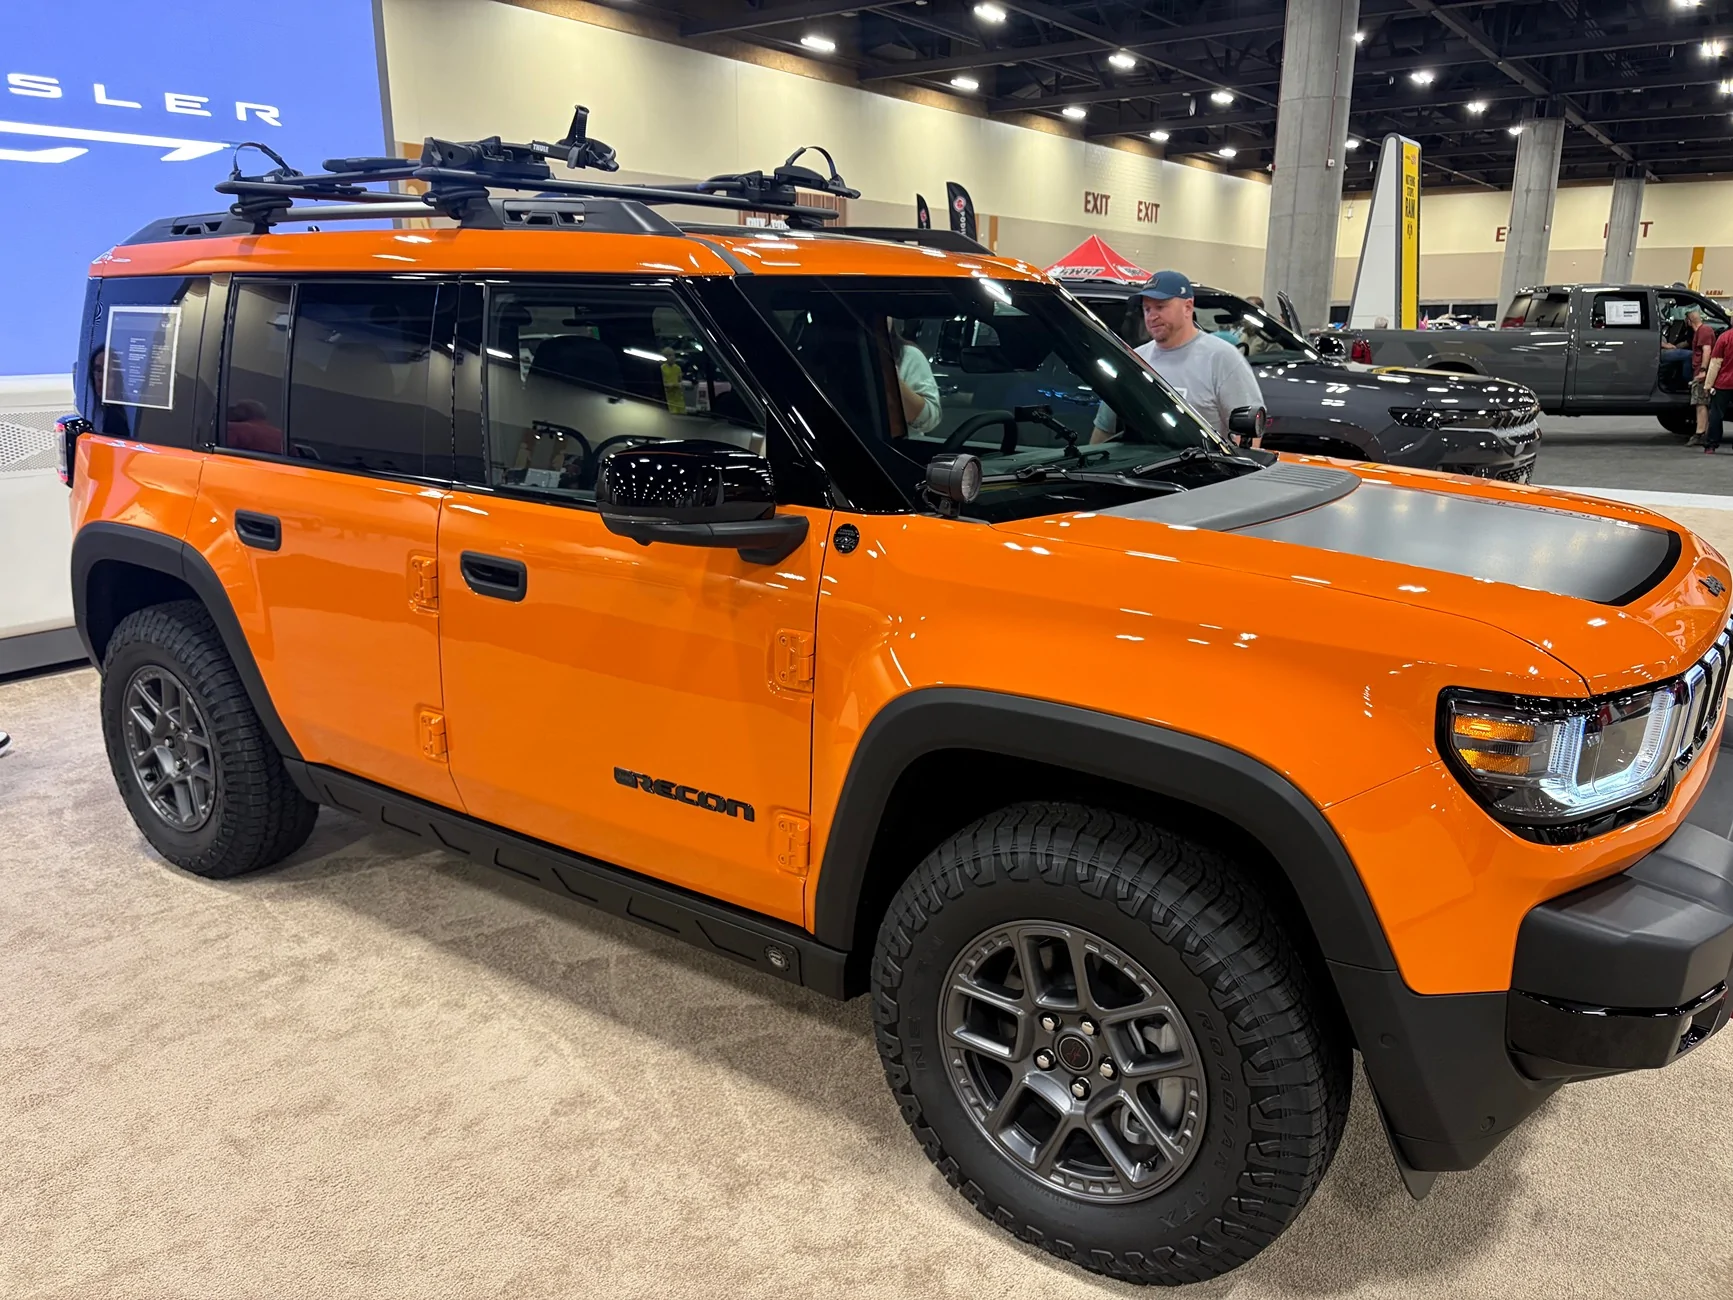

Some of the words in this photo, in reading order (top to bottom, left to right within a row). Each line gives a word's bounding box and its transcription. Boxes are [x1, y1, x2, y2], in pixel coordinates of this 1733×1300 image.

[532, 143, 549, 153] THULE
[1084, 191, 1111, 217] EXIT
[1137, 200, 1160, 224] EXIT
[613, 766, 755, 823] RECON
[1195, 1009, 1238, 1173] ROADIAN
